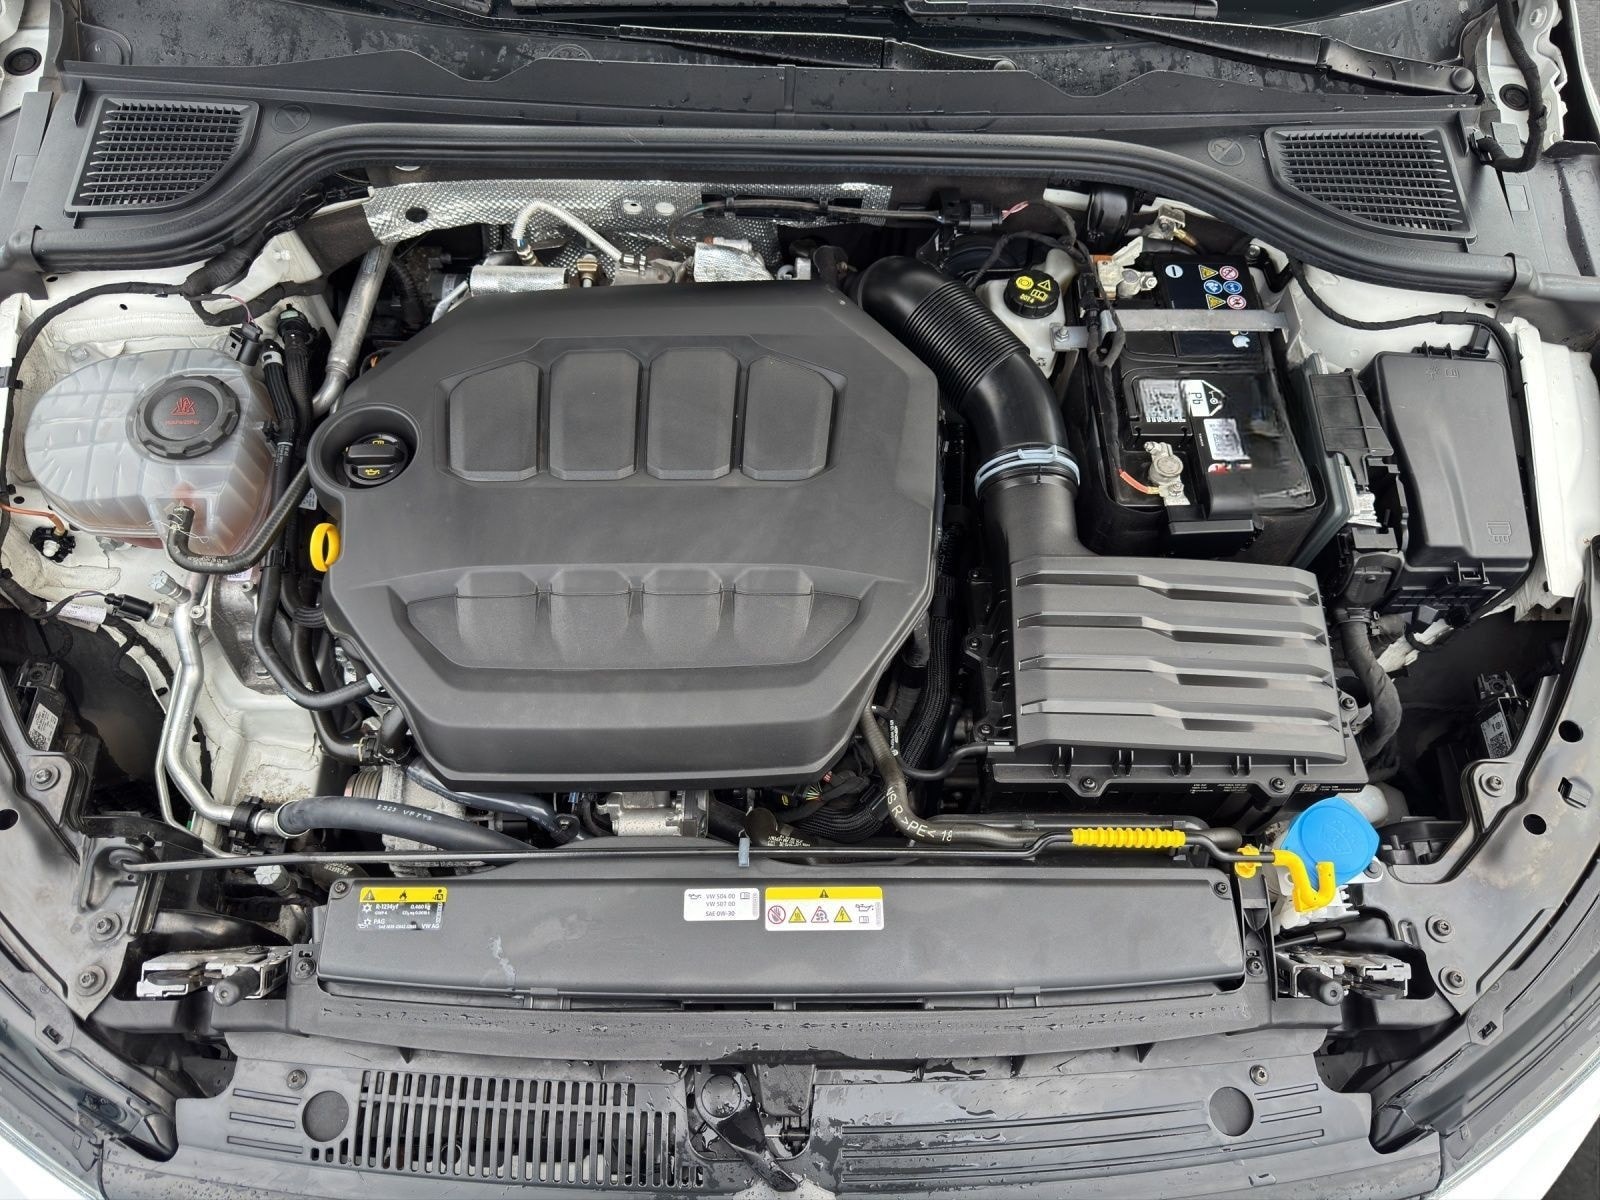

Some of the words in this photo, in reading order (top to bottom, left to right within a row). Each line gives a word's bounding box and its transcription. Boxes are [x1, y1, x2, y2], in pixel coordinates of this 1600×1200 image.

[1193, 392, 1203, 405] Pb
[941, 830, 953, 842] 18
[375, 903, 399, 911] R-1234yf
